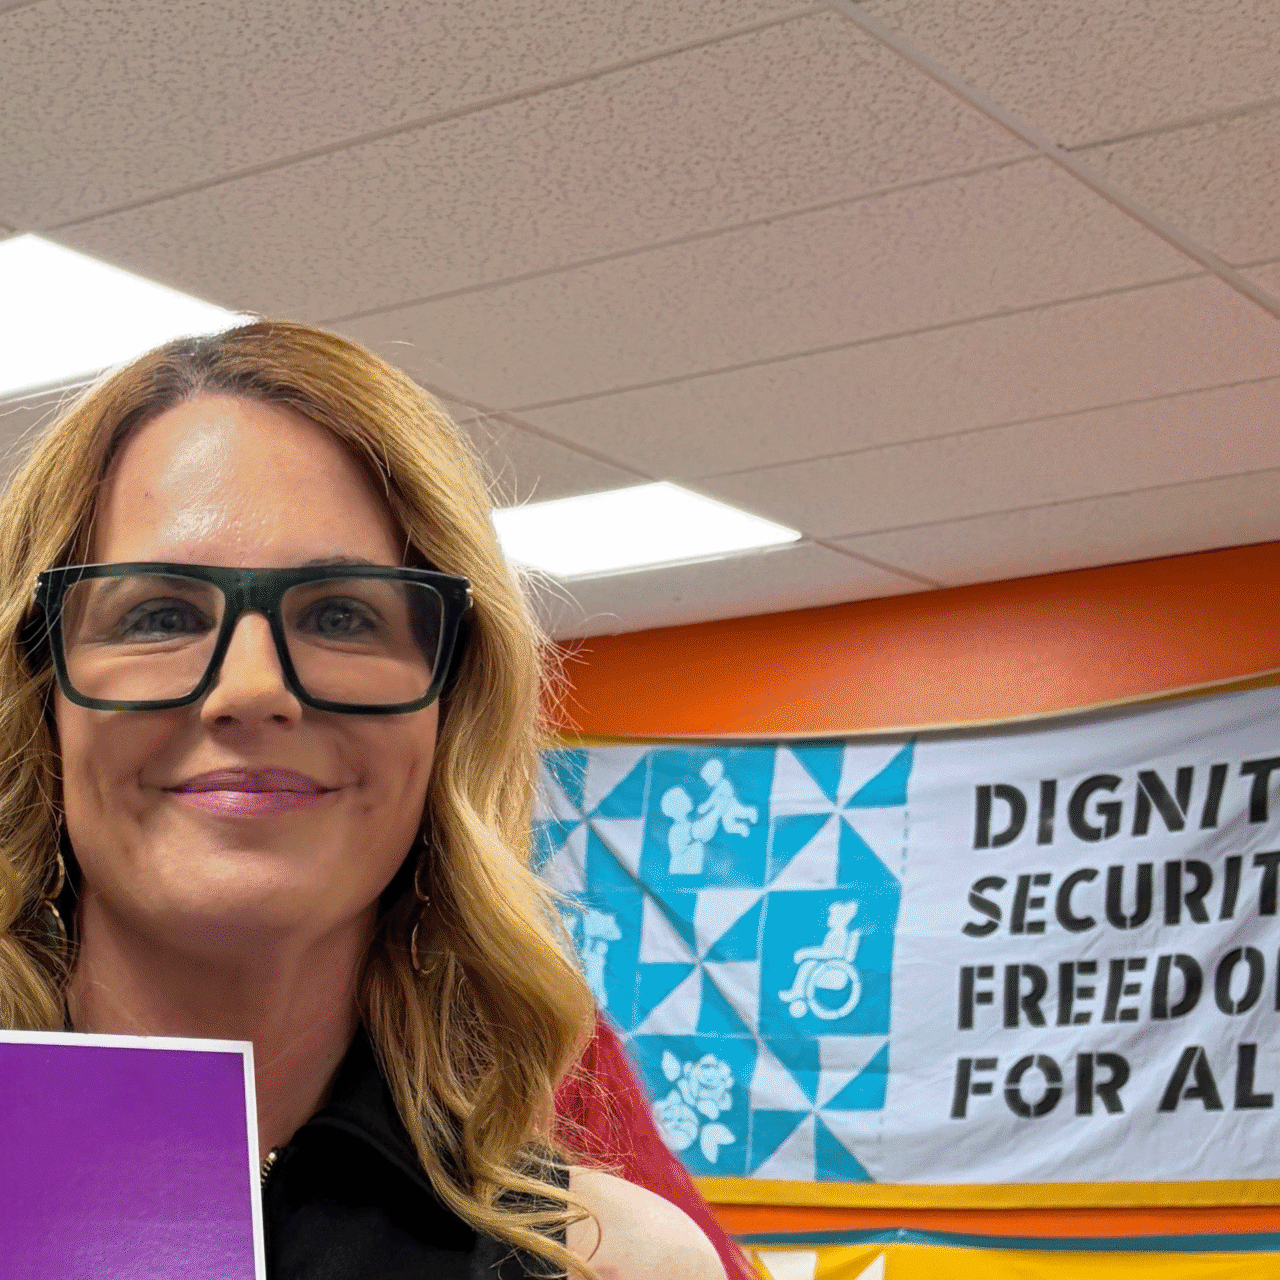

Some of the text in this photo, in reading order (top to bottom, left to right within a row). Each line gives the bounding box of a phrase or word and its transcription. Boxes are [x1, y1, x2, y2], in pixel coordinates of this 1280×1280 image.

[973, 757, 1280, 850] DIGNIT
[958, 946, 1280, 1030] FREEDO
[950, 1053, 1131, 1120] FOR
